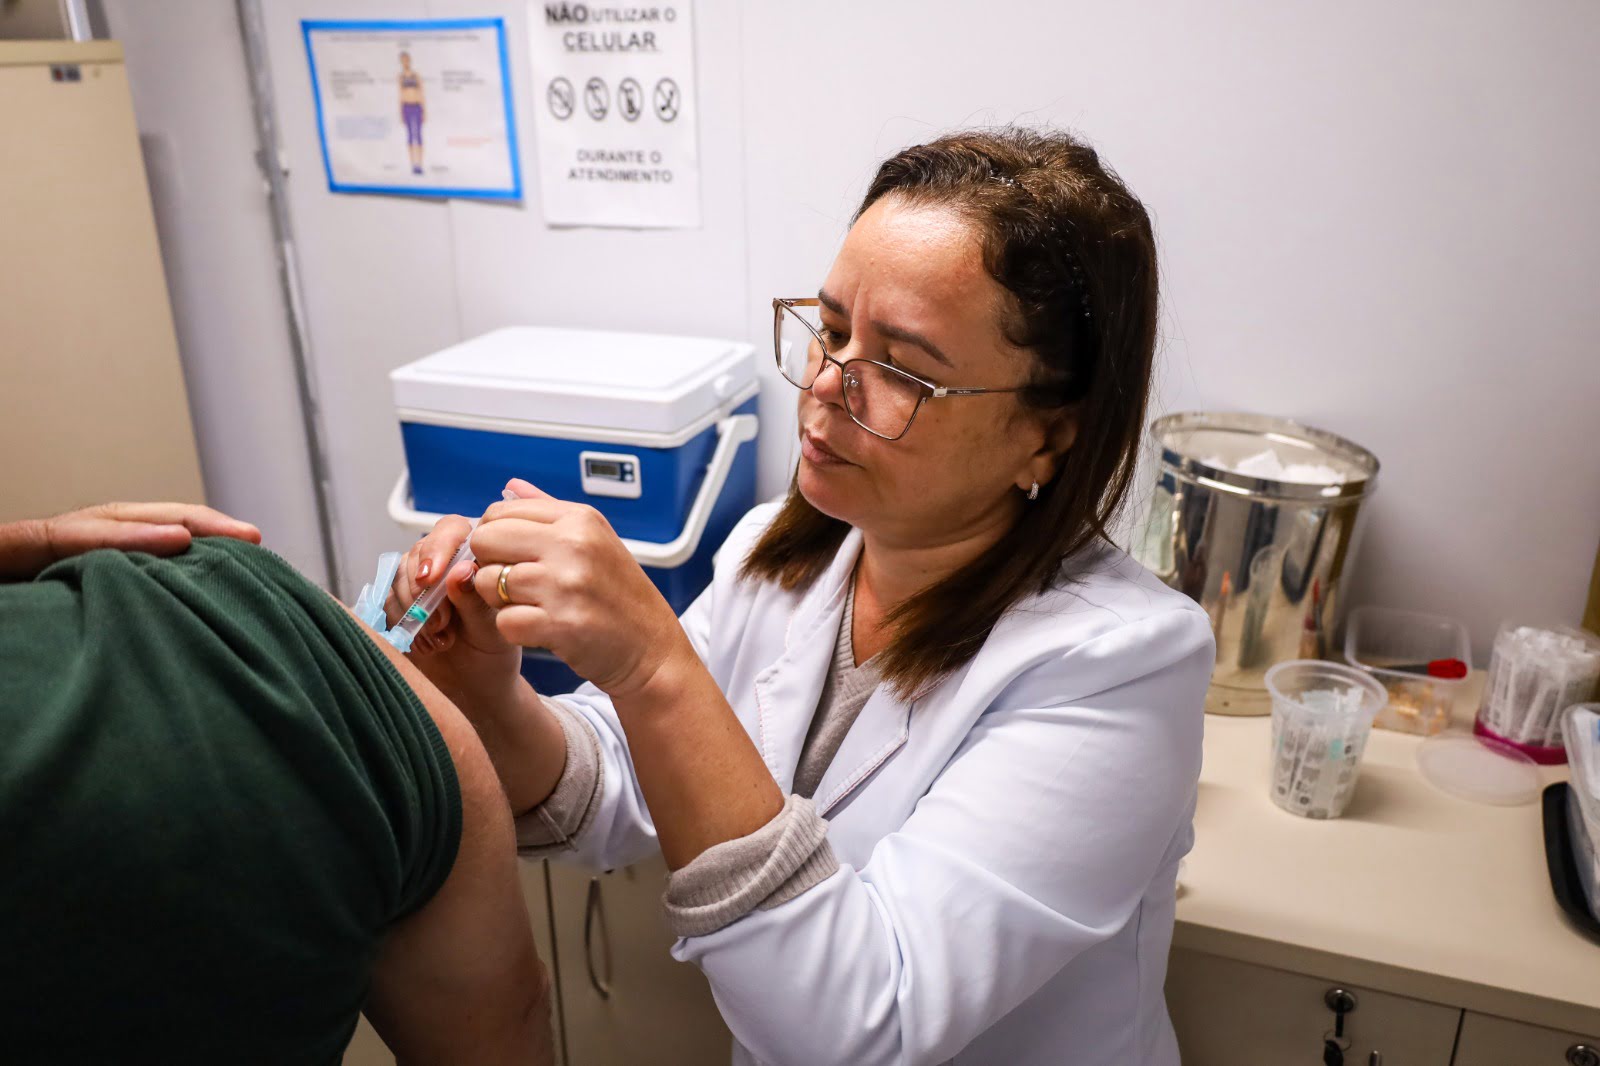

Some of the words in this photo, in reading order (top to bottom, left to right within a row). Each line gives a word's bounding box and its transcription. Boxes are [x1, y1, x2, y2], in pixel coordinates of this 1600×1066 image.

[545, 2, 588, 24] NÃO
[591, 8, 660, 22] UTILIZAR
[664, 7, 677, 22] O
[563, 31, 656, 50] CELULAR
[576, 150, 645, 164] DURANTE
[650, 150, 662, 164] O
[568, 168, 672, 183] ATENDIMENTO
